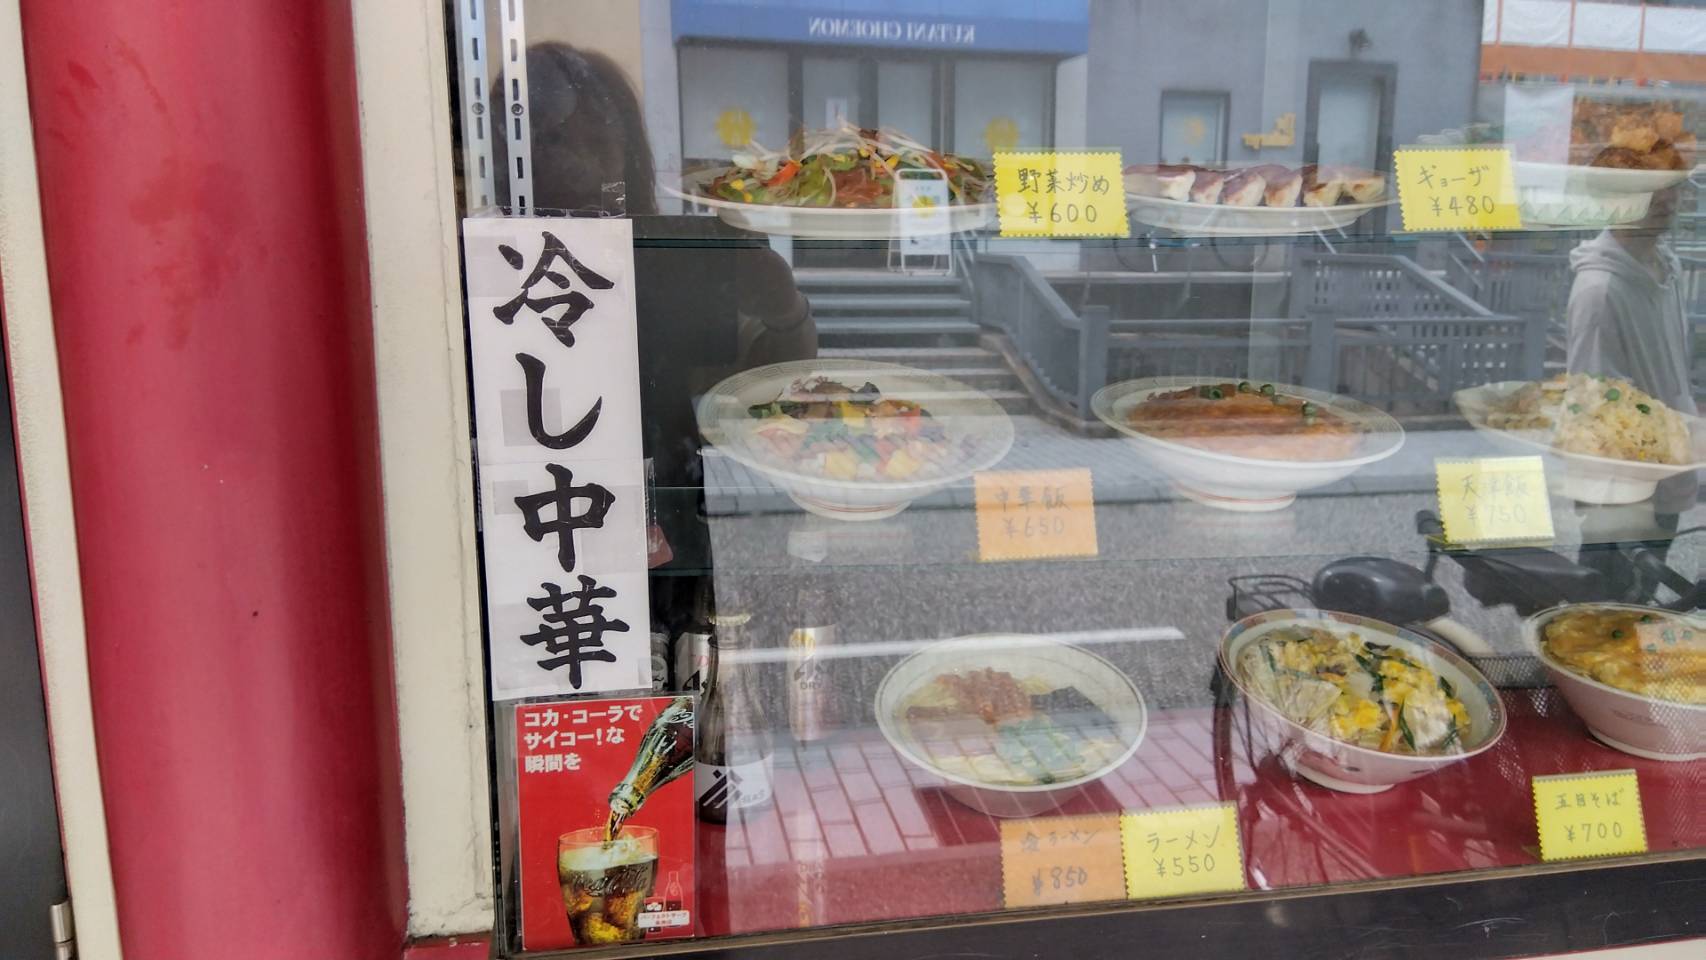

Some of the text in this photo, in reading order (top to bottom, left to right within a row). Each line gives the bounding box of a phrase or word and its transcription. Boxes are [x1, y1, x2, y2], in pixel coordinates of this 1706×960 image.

[1017, 168, 1110, 195] 野菜炒め
[1417, 165, 1490, 189] ギョーザ
[1027, 201, 1097, 223] ¥600
[1429, 195, 1495, 217] ¥480
[492, 230, 631, 690] 冷し中華
[1001, 516, 1065, 539] ¥650
[1465, 503, 1527, 529] ¥750
[524, 704, 643, 727] コカ・コーラで
[525, 752, 582, 773] 瞬間を
[1555, 787, 1625, 810] 五目そば
[1147, 825, 1220, 852] ラーメン
[1564, 822, 1622, 843] ¥700
[1153, 853, 1216, 877] ¥550
[1032, 866, 1088, 896] ¥850
